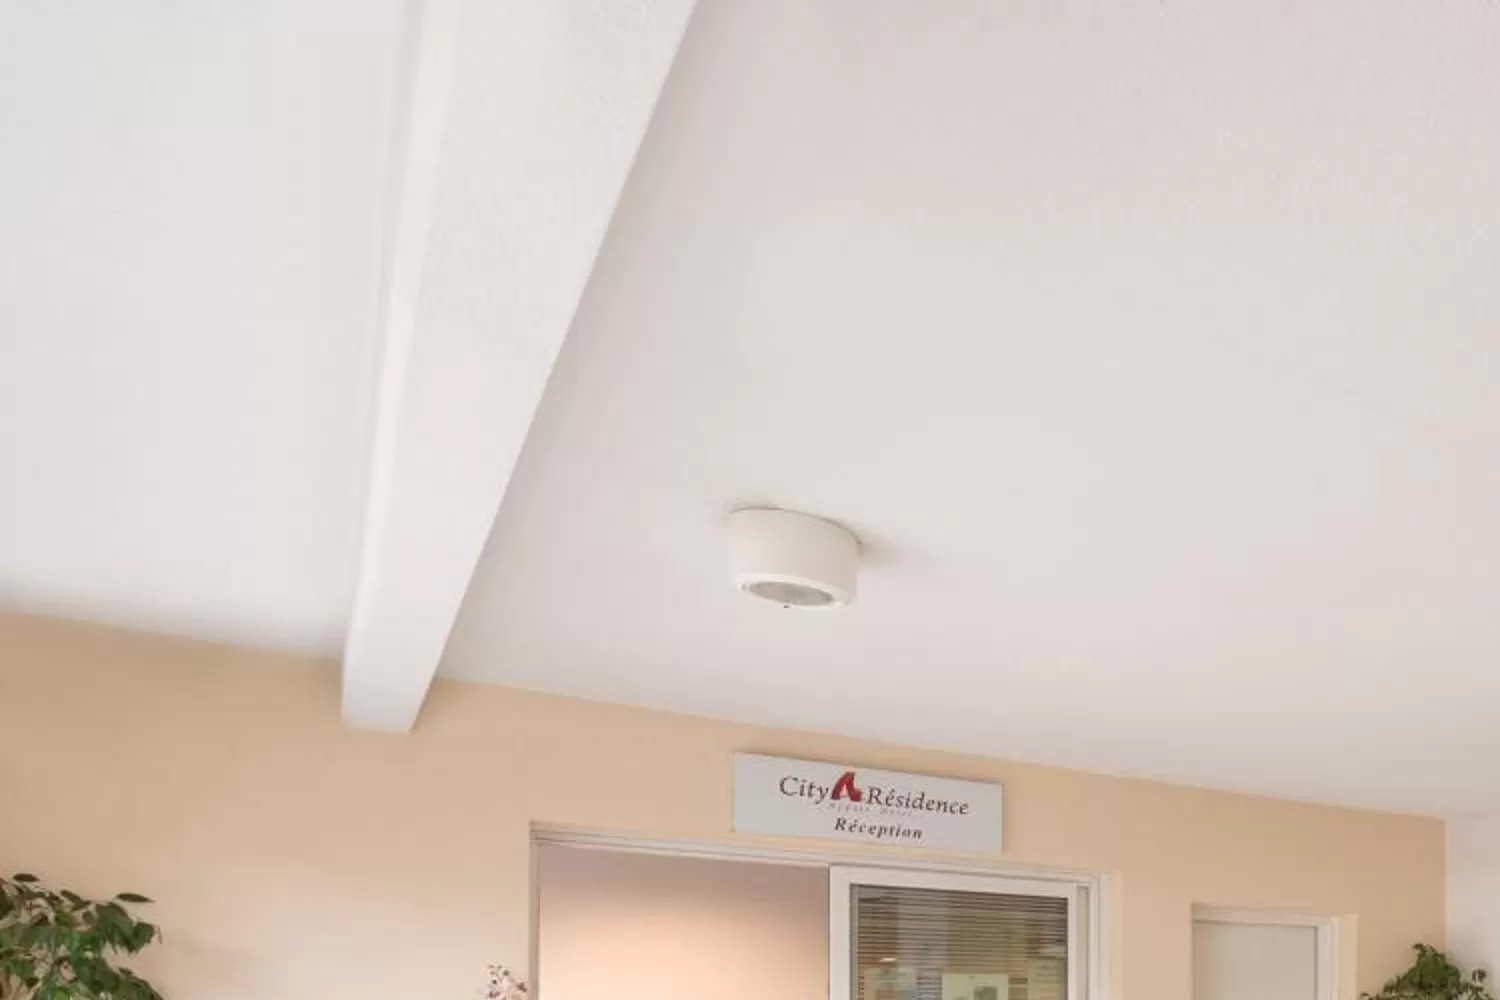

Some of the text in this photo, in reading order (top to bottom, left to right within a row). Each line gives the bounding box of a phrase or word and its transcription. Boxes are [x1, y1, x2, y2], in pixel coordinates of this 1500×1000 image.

[779, 775, 829, 805] City
[866, 785, 969, 815] Résidence
[834, 816, 923, 840] Réception
